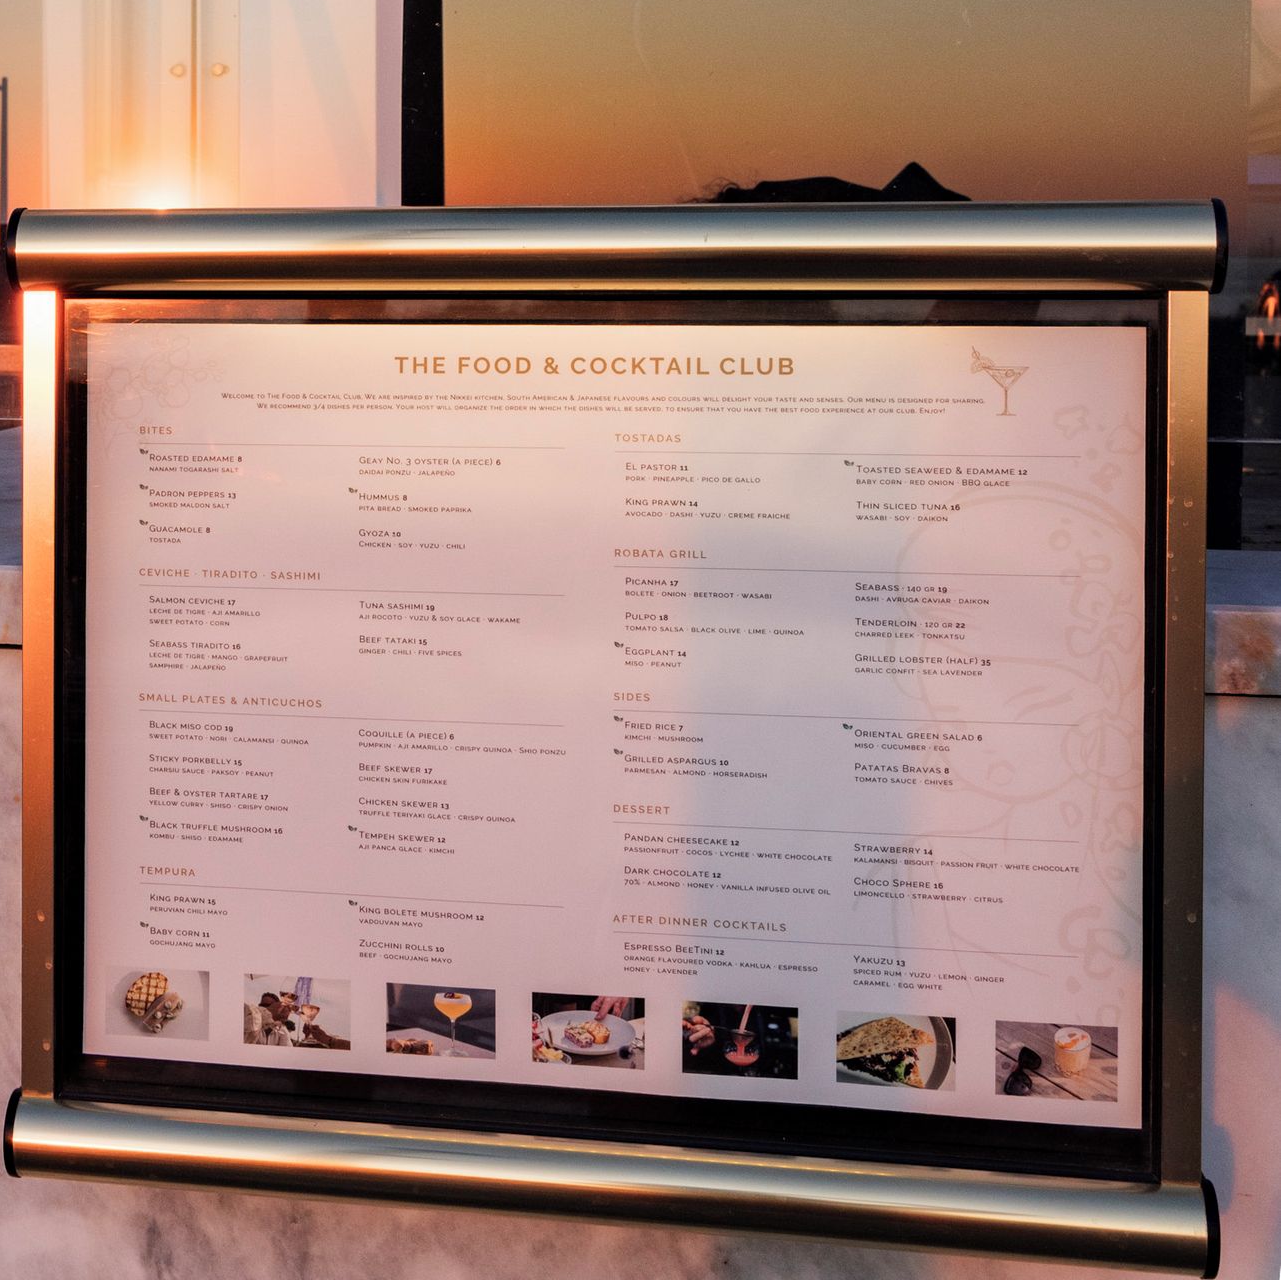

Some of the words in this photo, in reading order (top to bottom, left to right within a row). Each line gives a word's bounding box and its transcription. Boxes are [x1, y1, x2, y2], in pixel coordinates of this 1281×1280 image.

[394, 356, 445, 374] THE
[458, 357, 531, 374] FOOD
[544, 356, 559, 375] &
[570, 357, 710, 375] COCKTAIL
[719, 357, 794, 375] CLUB
[139, 426, 172, 435] BITES
[615, 433, 681, 443] TOSTADAS
[950, 503, 961, 511] 16
[205, 526, 211, 534] 8
[614, 548, 664, 558] ROBATA
[669, 549, 707, 559] GRILL
[139, 568, 189, 577] CEVICHE
[202, 569, 258, 579] TIRADITO
[271, 571, 320, 580] SASHIMI
[938, 586, 948, 594] 19
[426, 604, 435, 612] 19
[419, 638, 428, 646] 15
[981, 659, 991, 667] 35
[139, 693, 177, 703] SMALL
[182, 694, 226, 704] PLATES
[230, 696, 237, 705] &
[242, 697, 322, 708] ANTICUCHOS
[614, 692, 650, 702] SIDES
[225, 725, 234, 733] 19
[449, 733, 455, 741] 6
[234, 759, 242, 767] 15
[174, 788, 180, 796] &
[613, 804, 670, 815] DESSERT
[924, 848, 933, 856] 14
[140, 866, 195, 877] TEMPURA
[934, 882, 944, 890] 16
[208, 898, 216, 906] 15
[613, 914, 653, 924] AFTER
[659, 916, 708, 927] DINNER
[713, 919, 786, 932] COCKTAILS
[896, 959, 905, 967] 13
